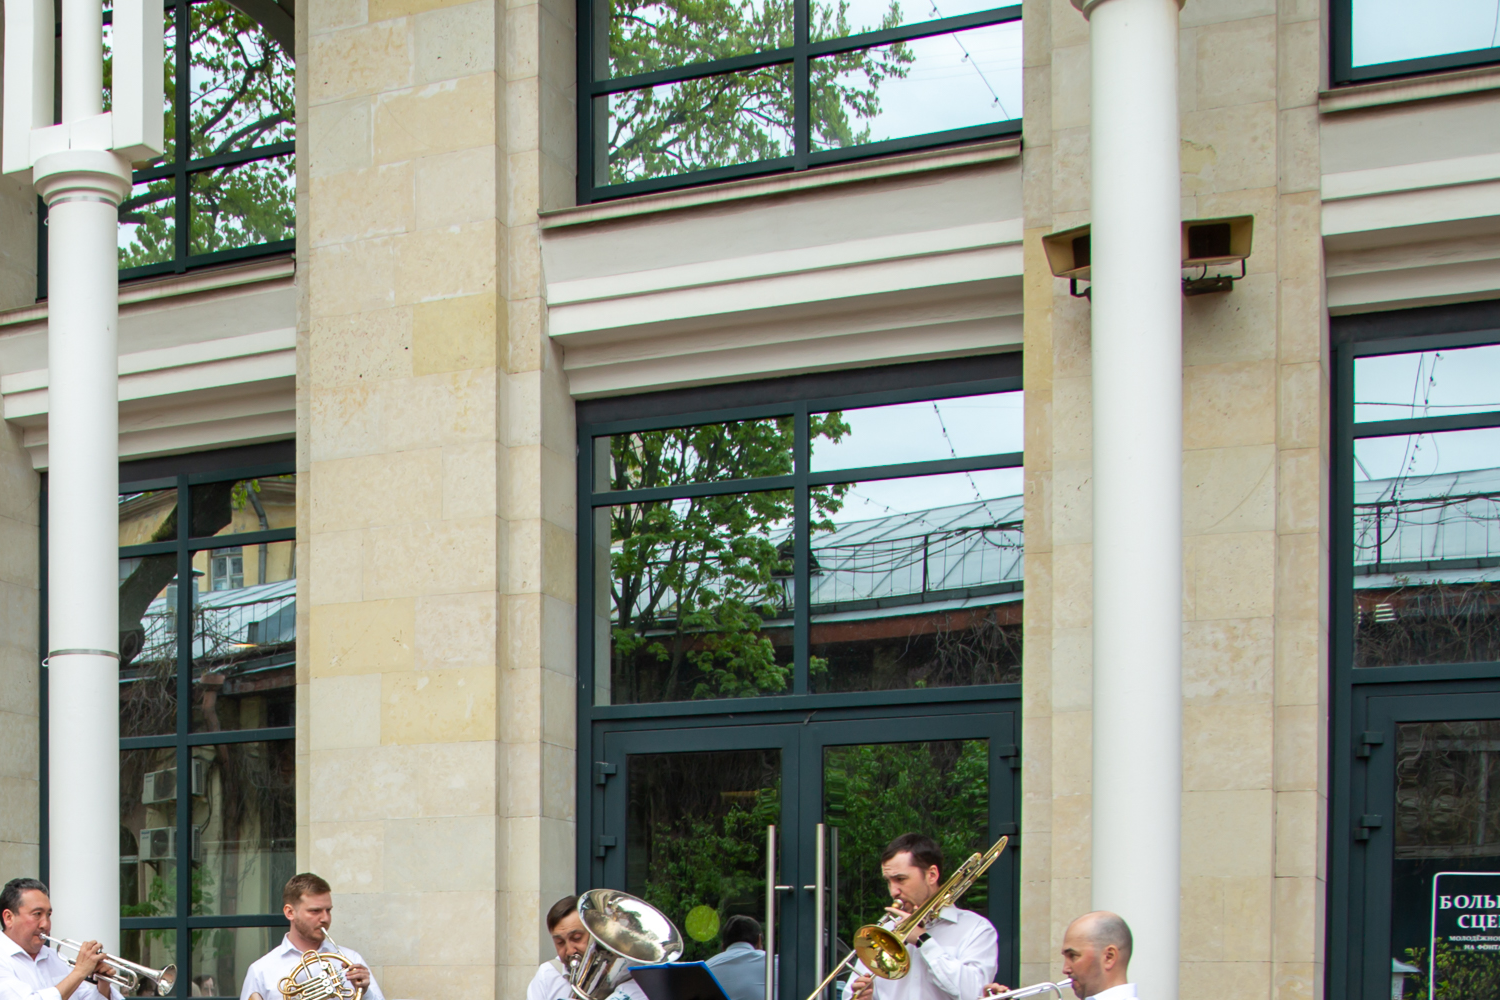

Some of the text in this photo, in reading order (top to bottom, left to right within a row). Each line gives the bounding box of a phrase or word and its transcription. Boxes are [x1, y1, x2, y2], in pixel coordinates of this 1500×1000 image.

[1439, 894, 1500, 910] БОЛЬ
[1457, 914, 1500, 931] СЦЕ
[1449, 934, 1500, 942] МОЛОДЁЖНО
